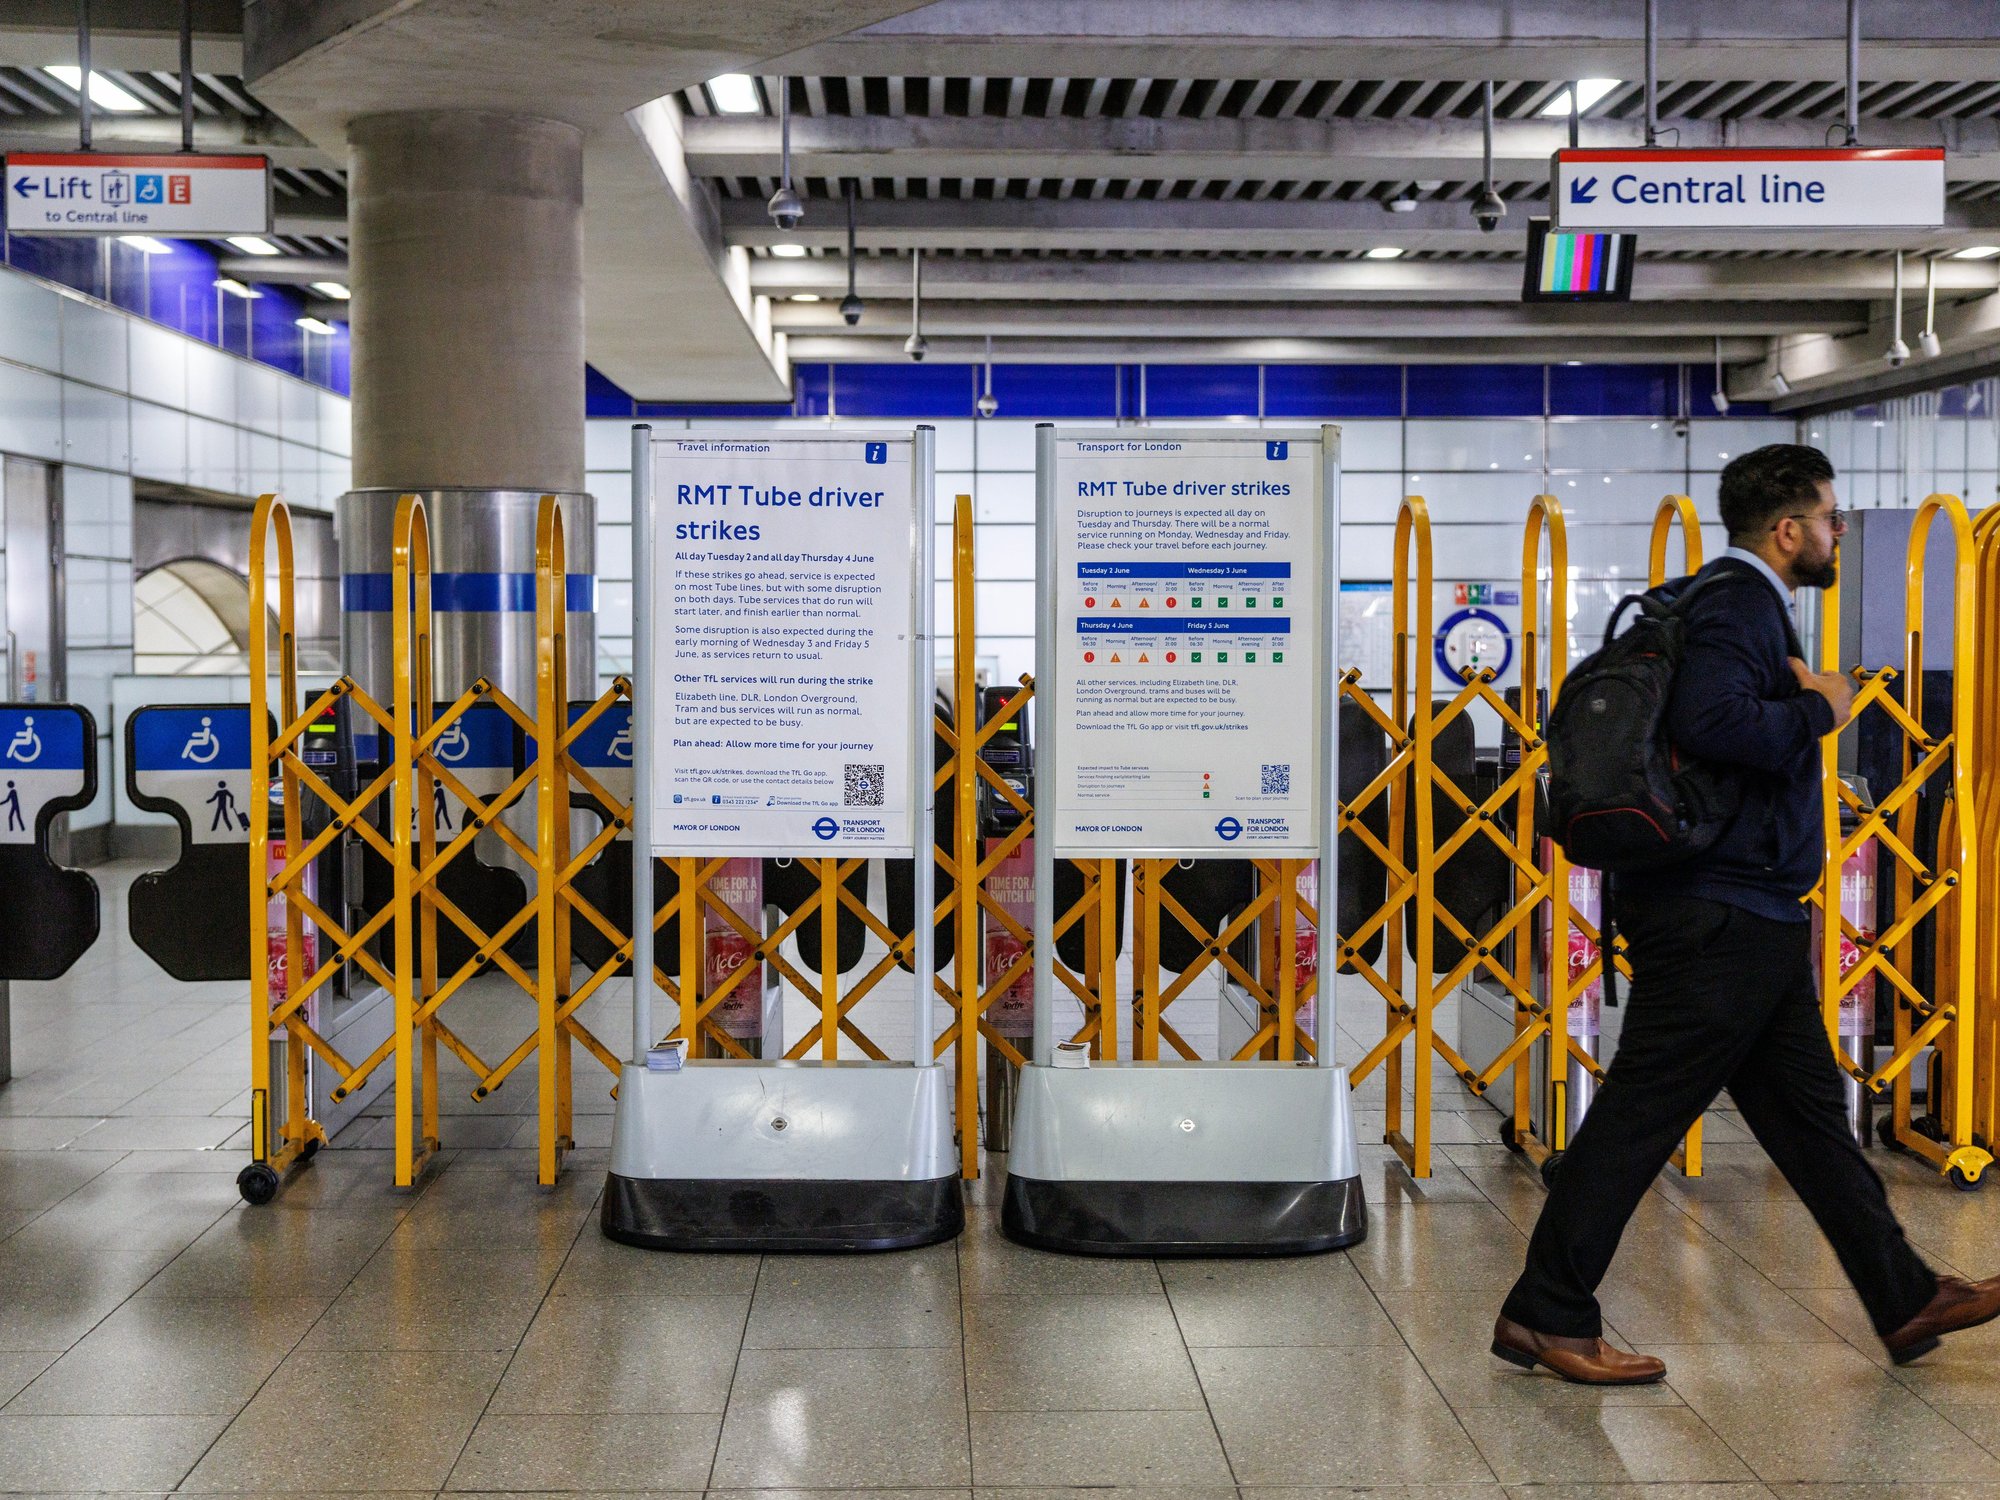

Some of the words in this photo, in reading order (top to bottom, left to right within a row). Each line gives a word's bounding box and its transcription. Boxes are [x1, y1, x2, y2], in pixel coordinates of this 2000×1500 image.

[44, 176, 92, 199] Lift
[174, 185, 186, 201] E
[1611, 174, 1745, 204] Central
[1761, 174, 1825, 203] line
[45, 211, 60, 222] to
[66, 210, 117, 223] Central
[123, 210, 148, 223] line
[677, 443, 708, 451] Travel
[711, 443, 770, 452] information
[1077, 443, 1124, 453] Transport
[1127, 442, 1142, 451] for
[1145, 442, 1182, 451] London
[1079, 482, 1117, 496] RMT
[1123, 481, 1167, 496] Tube
[1173, 481, 1226, 496] driver
[1232, 481, 1290, 496] strikes
[678, 485, 732, 505] RMT
[738, 486, 801, 506] Tube
[809, 486, 884, 508] driver
[1078, 510, 1122, 519] Disruption
[1136, 510, 1173, 519] journeys
[1175, 509, 1182, 517] is
[1184, 509, 1222, 518] expected
[1224, 509, 1235, 517] all
[1237, 509, 1252, 518] day
[676, 519, 760, 541] strikes
[1077, 521, 1112, 529] Tuesday
[1114, 520, 1130, 528] and
[1132, 520, 1172, 529] Thursday.
[1175, 520, 1199, 528] There
[1201, 520, 1217, 528] will
[1219, 520, 1230, 528] be
[1110, 531, 1142, 540] running
[1195, 531, 1244, 540] Wednesday
[1264, 530, 1290, 540] Friday.
[1182, 541, 1210, 549] before
[1233, 542, 1267, 551] journey.
[675, 552, 688, 560] All
[689, 552, 706, 562] day
[707, 552, 745, 562] Tuesday
[784, 554, 800, 563] day
[801, 554, 844, 564] Thursday
[852, 554, 874, 562] June
[676, 570, 682, 578] If
[685, 570, 710, 578] these
[712, 571, 742, 579] strikes
[744, 573, 756, 581] go
[834, 573, 875, 582] expected
[715, 583, 738, 591] Tube
[766, 584, 782, 592] but
[784, 584, 805, 592] with
[835, 585, 881, 594] disruption
[689, 595, 710, 603] both
[713, 596, 736, 605] days.
[738, 596, 761, 604] Tube
[802, 597, 821, 605] that
[824, 597, 835, 605] do
[725, 608, 741, 616] and
[744, 608, 769, 616] finish
[771, 609, 800, 617] earlier
[802, 609, 823, 617] than
[826, 610, 861, 618] normal.
[1081, 622, 1110, 630] Thursday
[674, 674, 701, 682] Other
[704, 675, 718, 683] TfL
[721, 676, 757, 684] services
[760, 676, 777, 684] will
[798, 676, 827, 686] during
[830, 677, 845, 685] the
[848, 677, 873, 685] strike
[674, 739, 692, 747] Plan
[726, 740, 752, 748] Allow
[780, 741, 800, 749] time
[802, 741, 815, 749] for
[818, 743, 838, 751] your
[840, 742, 874, 751] journey
[1247, 826, 1260, 834] FOR
[1261, 826, 1289, 834] LONDON
[732, 877, 748, 889] FOR
[751, 877, 757, 889] A
[989, 877, 1010, 889] TIME
[1012, 877, 1029, 889] FOR
[1593, 875, 1599, 888] A
[745, 890, 757, 903] UP
[990, 889, 1023, 903] SWITCH
[1588, 889, 1598, 902] UP
[1863, 889, 1873, 902] UP
[1002, 1001, 1024, 1010] Sprite
